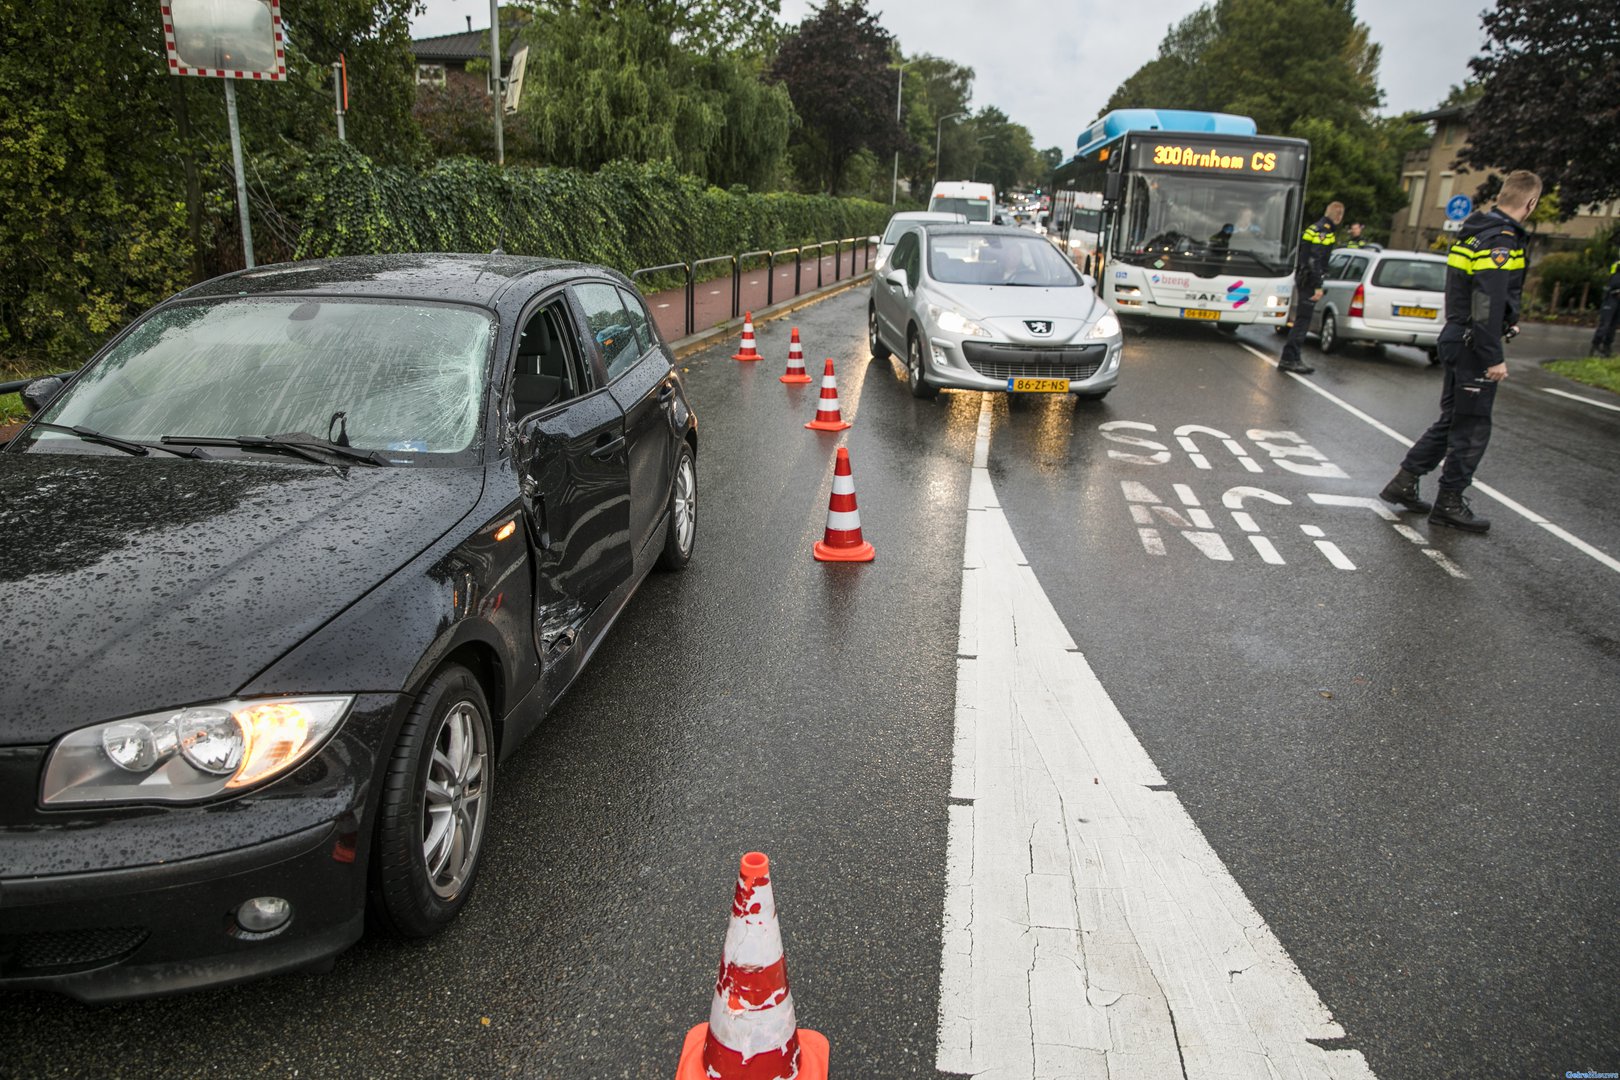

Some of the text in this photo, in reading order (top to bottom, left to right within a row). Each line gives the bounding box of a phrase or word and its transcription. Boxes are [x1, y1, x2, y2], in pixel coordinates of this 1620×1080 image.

[1153, 145, 1277, 172] 300 Arnhem CS
[1161, 273, 1190, 289] breng
[1017, 380, 1065, 391] 86-ZF-NS
[1098, 420, 1350, 479] BUS
